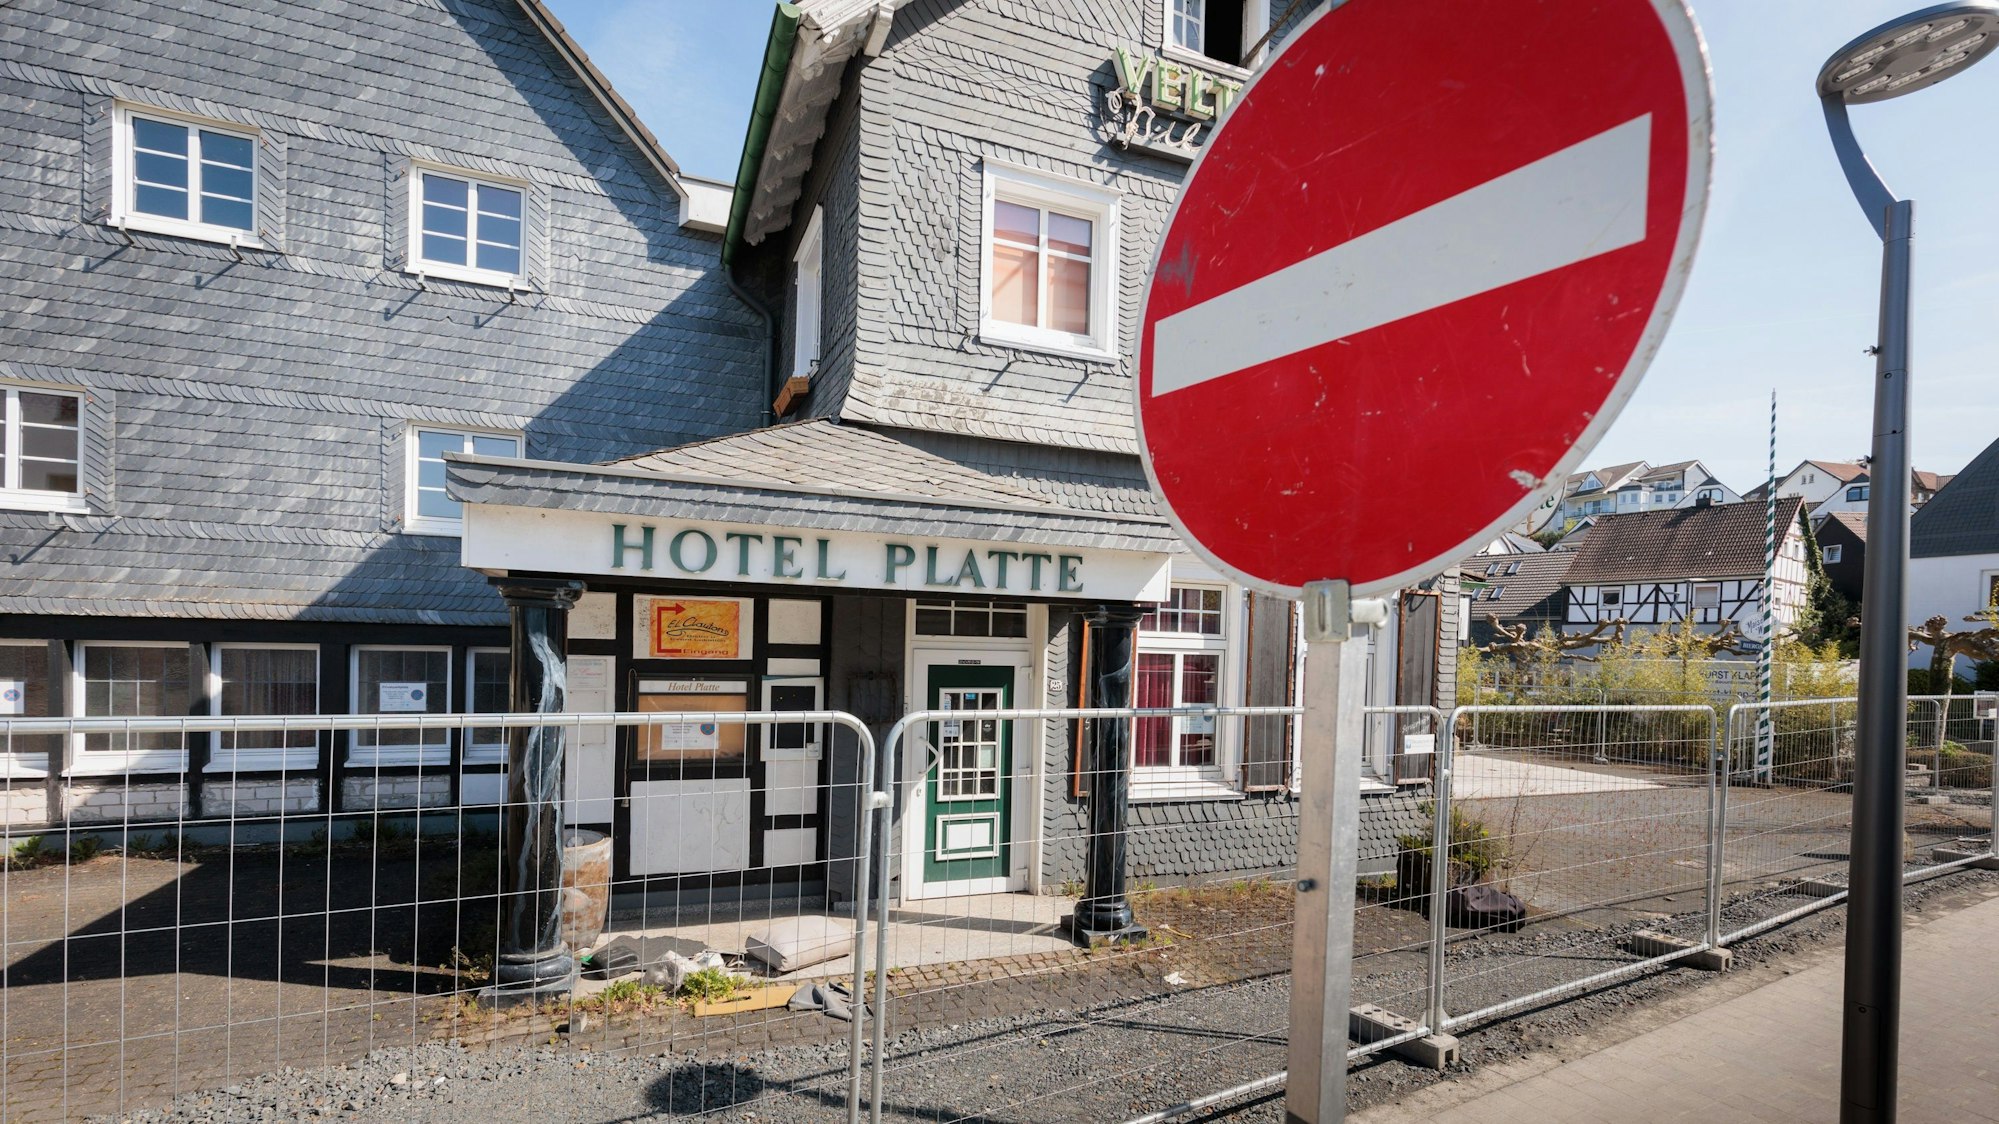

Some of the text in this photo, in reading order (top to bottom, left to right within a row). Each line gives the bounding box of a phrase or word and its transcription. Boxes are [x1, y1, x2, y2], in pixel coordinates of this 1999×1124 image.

[1111, 47, 1244, 121] VELT
[611, 523, 1084, 593] HOTEL PLATTE
[683, 648, 729, 656] Eingang
[667, 682, 720, 692] Hotel Platte
